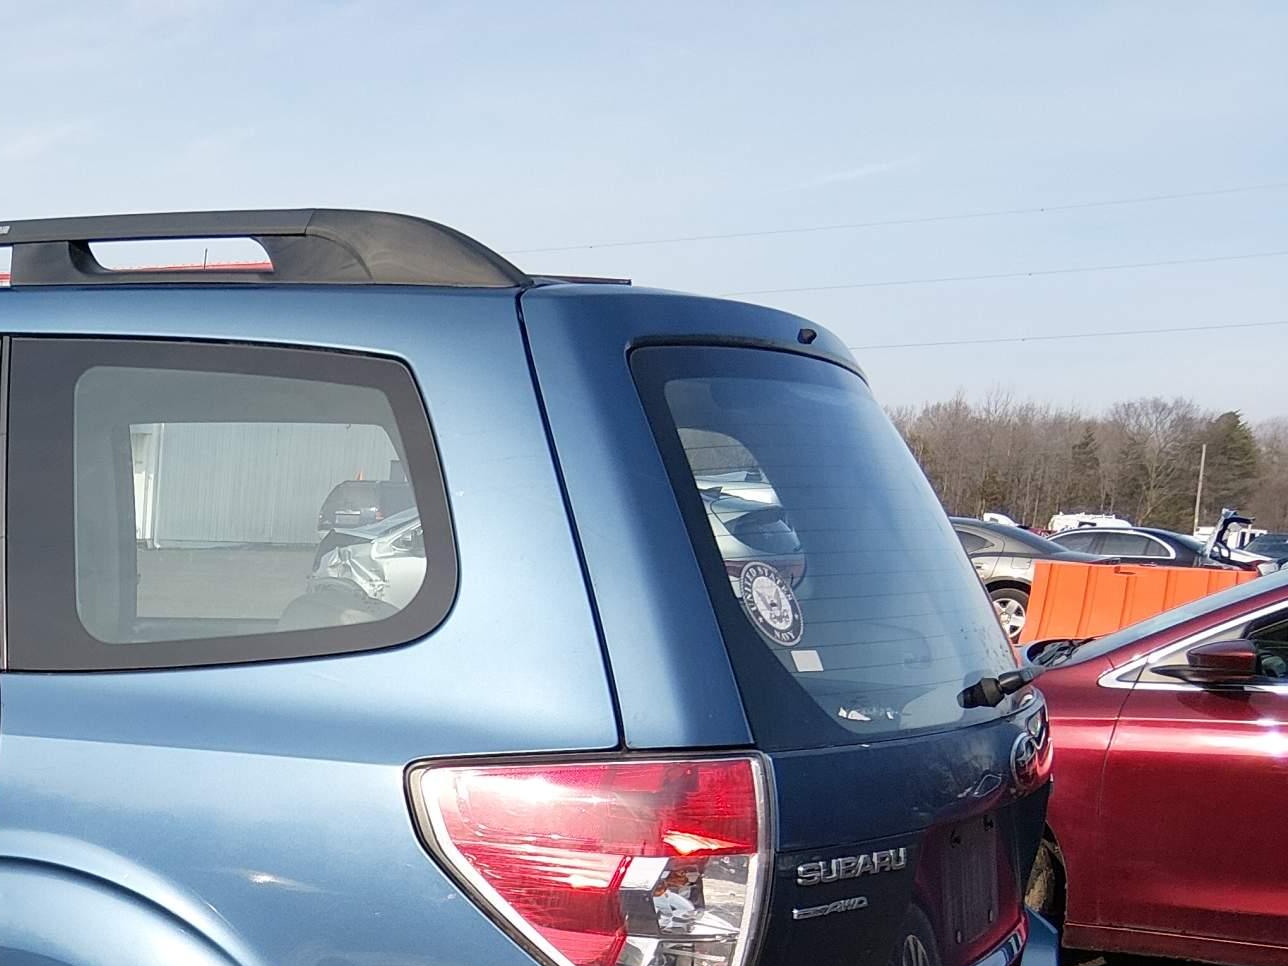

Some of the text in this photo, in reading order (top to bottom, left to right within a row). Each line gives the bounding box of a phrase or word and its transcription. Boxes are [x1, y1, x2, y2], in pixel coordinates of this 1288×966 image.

[744, 566, 793, 610] UNITED STATES
[773, 629, 795, 641] NAVY
[797, 847, 907, 886] SUBARU
